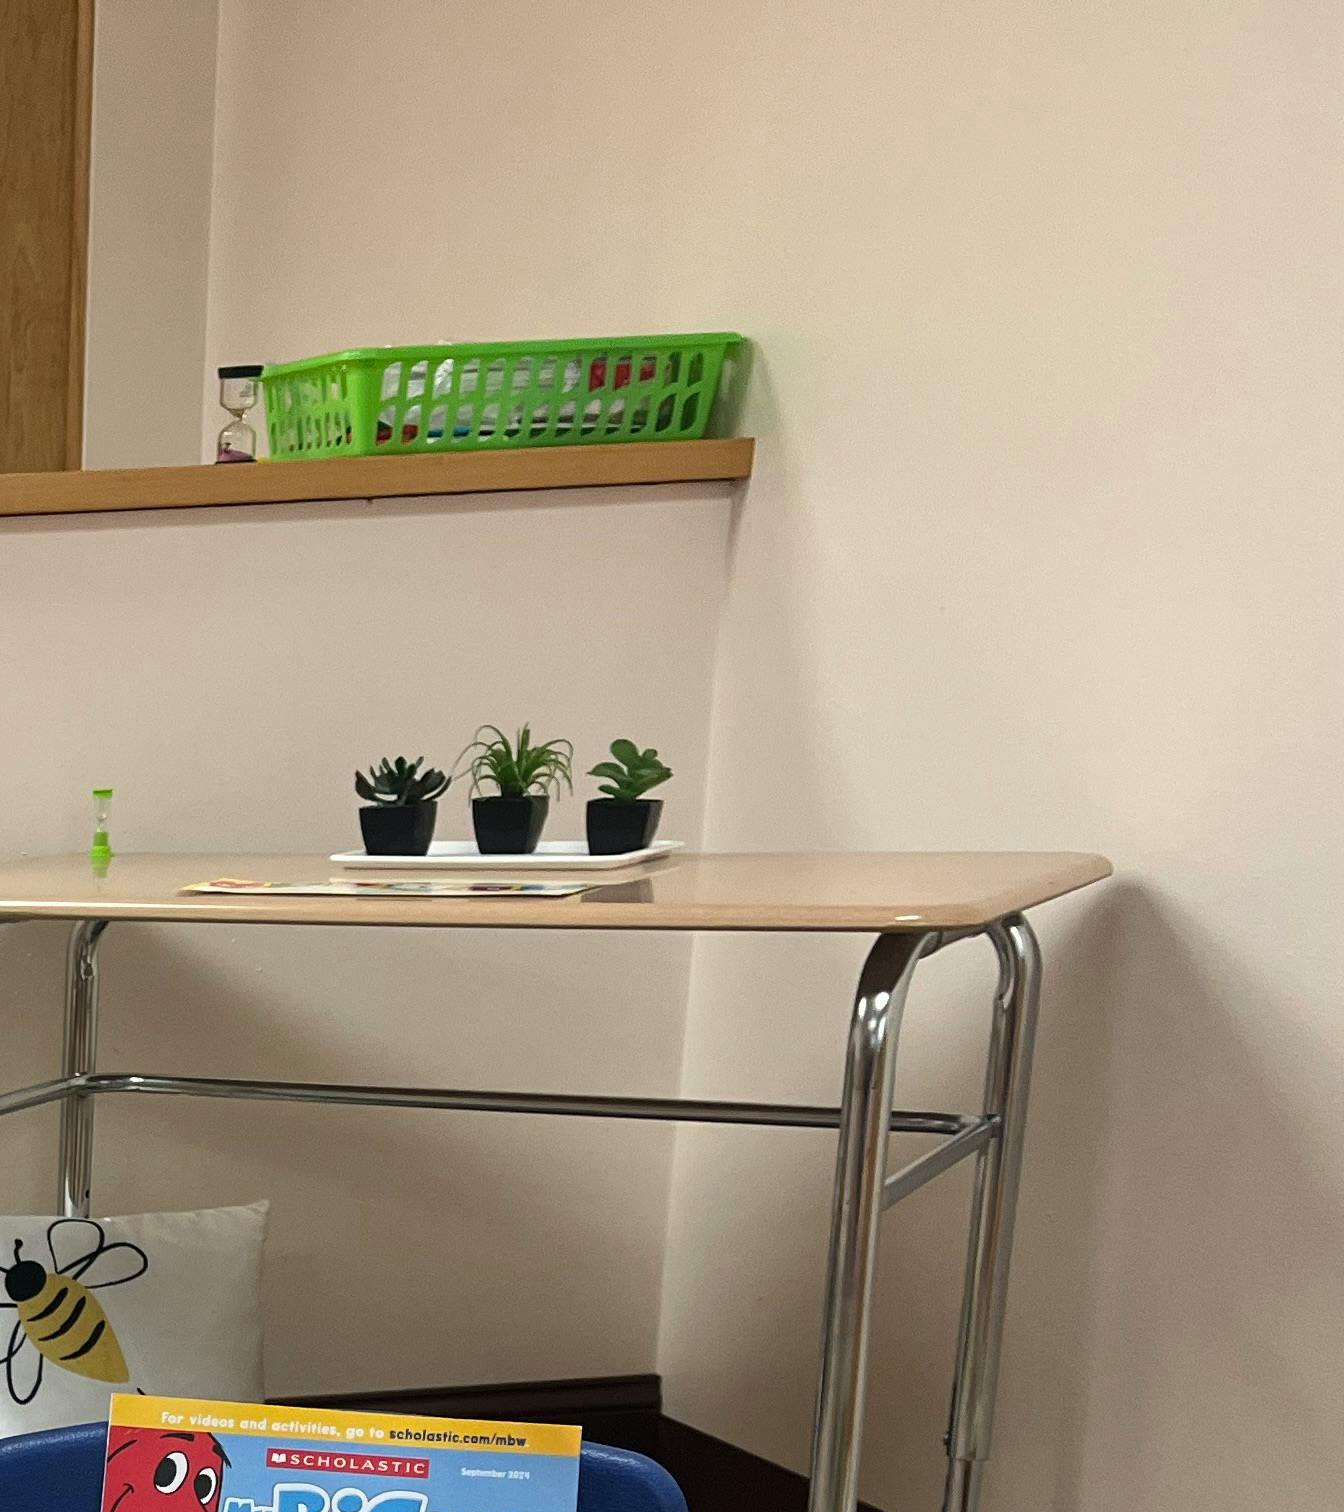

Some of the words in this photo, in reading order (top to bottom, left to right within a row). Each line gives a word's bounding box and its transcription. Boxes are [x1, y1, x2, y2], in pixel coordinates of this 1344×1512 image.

[161, 1411, 184, 1425] For
[190, 1414, 234, 1429] videos
[240, 1417, 267, 1432] and
[272, 1420, 341, 1437] activities,
[346, 1427, 365, 1440] go
[369, 1427, 385, 1439] to
[389, 1428, 527, 1448] scholastic.com/mbw
[290, 1454, 425, 1475] SCHOLASTIC
